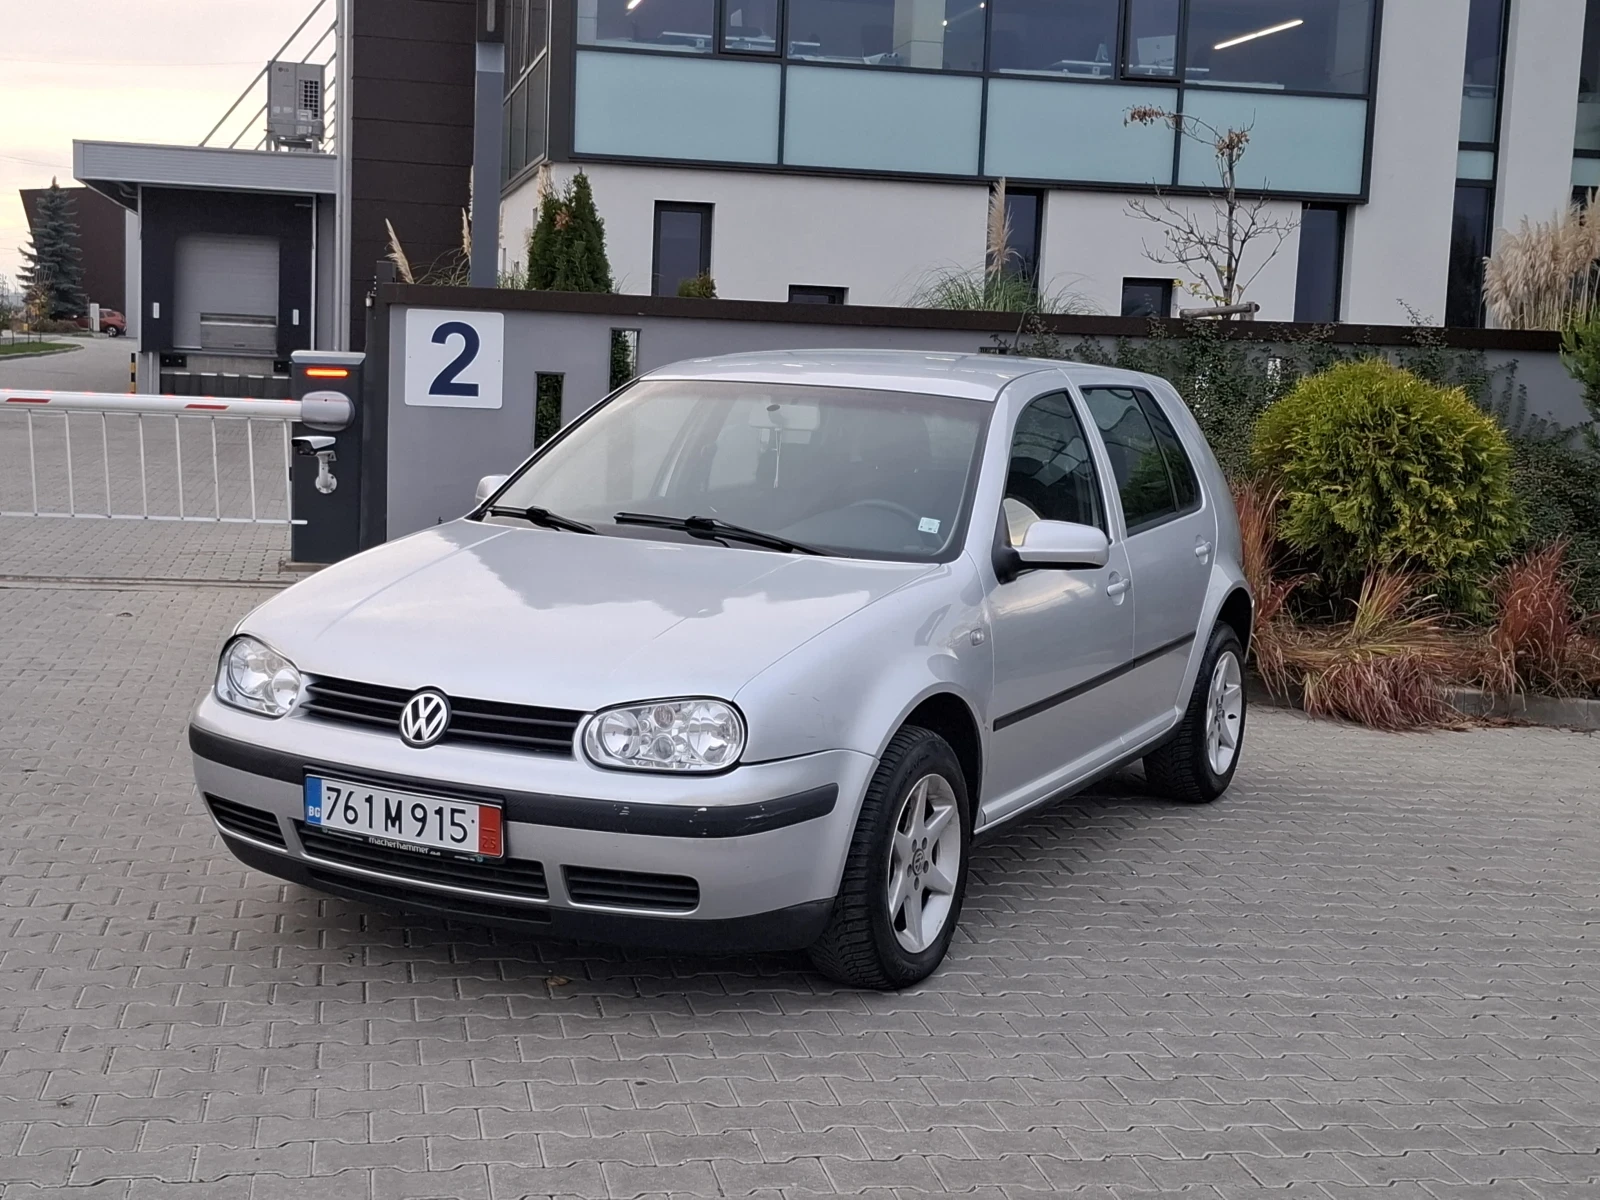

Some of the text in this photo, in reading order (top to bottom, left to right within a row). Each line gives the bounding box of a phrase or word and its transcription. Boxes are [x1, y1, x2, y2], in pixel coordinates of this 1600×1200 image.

[428, 321, 480, 397] 2
[401, 693, 448, 743] VW
[308, 805, 321, 818] BG
[368, 836, 430, 854] macherhammer
